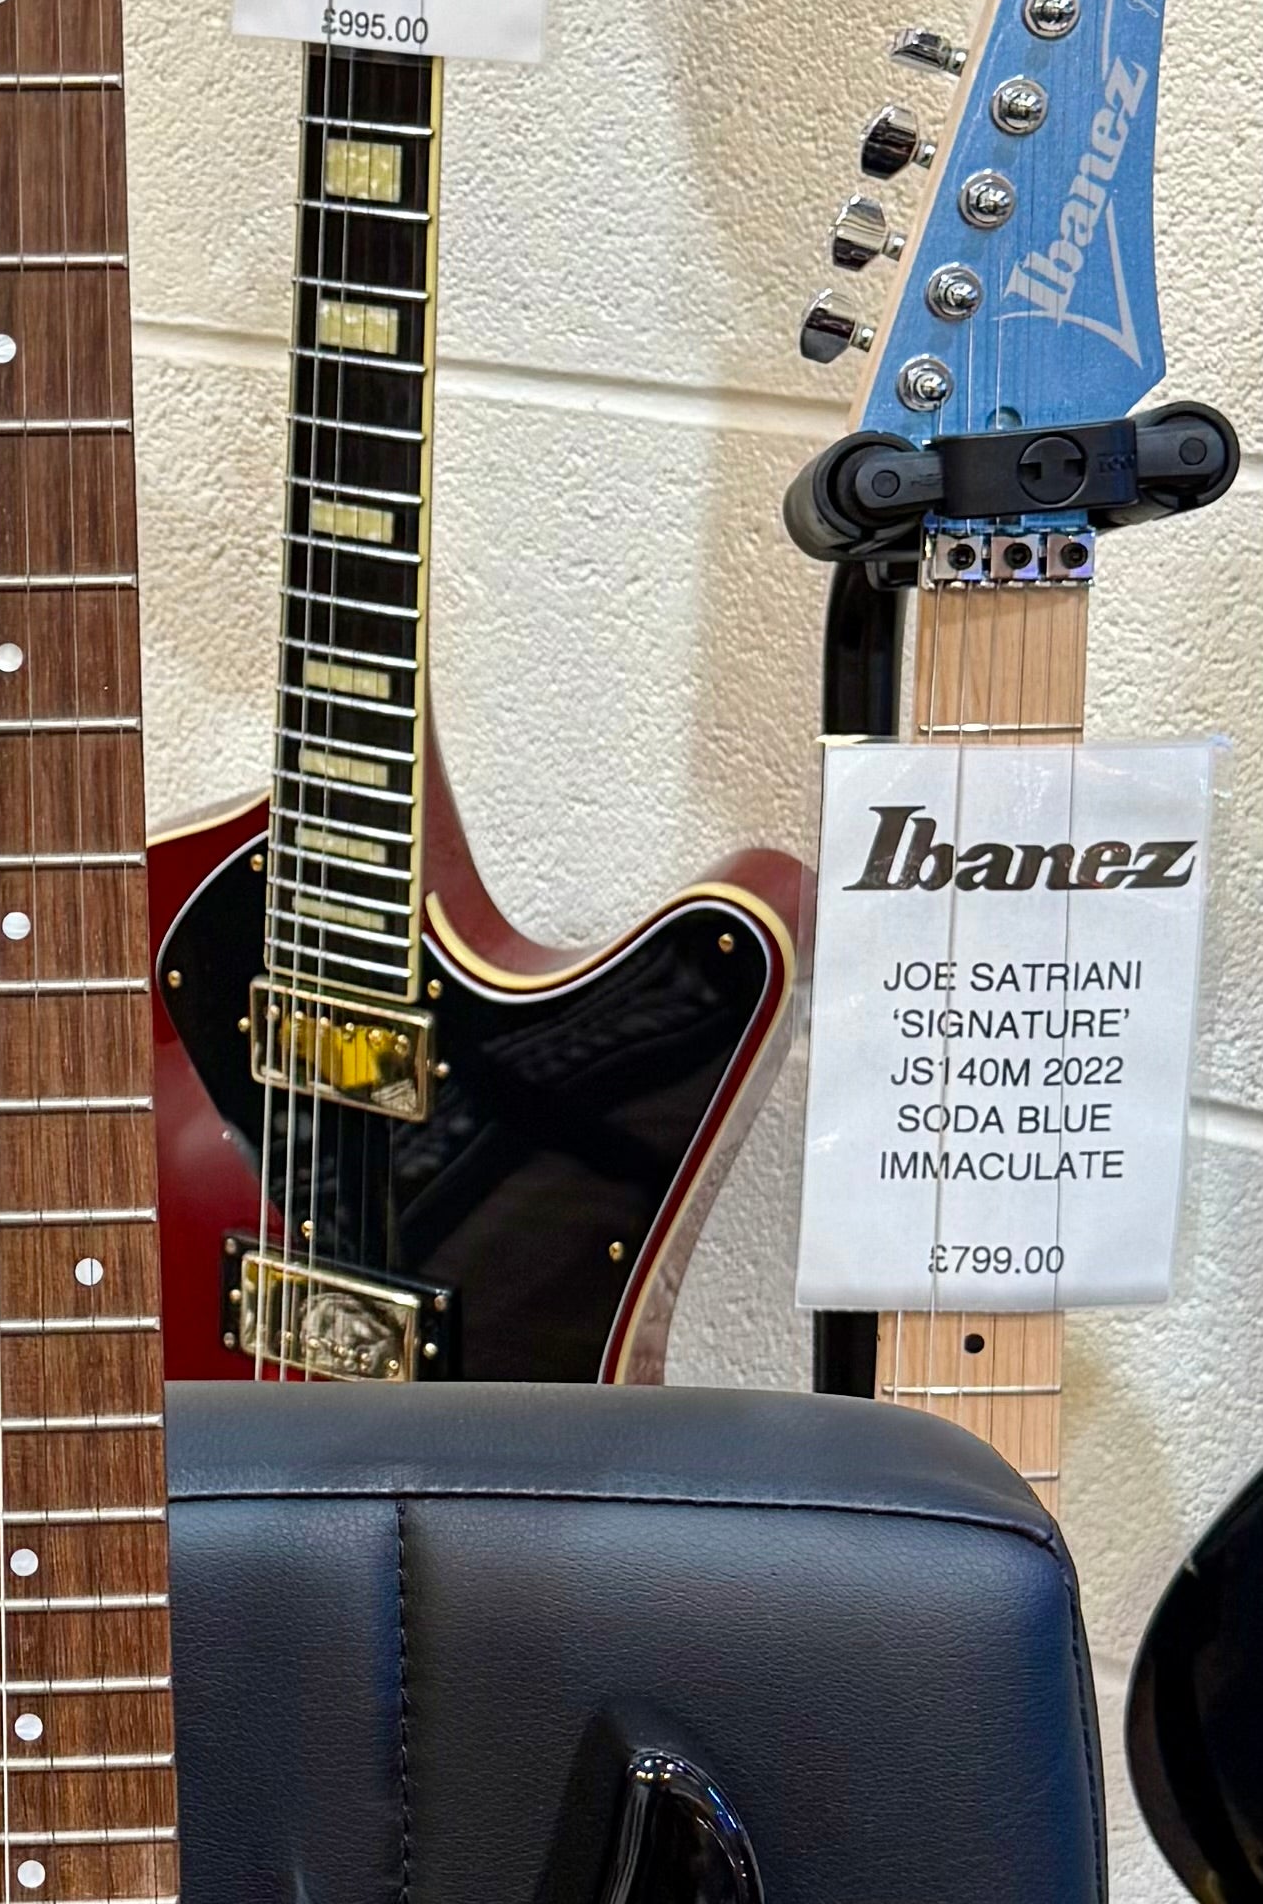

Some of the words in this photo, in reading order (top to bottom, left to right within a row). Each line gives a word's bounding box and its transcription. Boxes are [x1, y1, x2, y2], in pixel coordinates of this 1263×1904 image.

[321, 7, 429, 44] £995.00
[1002, 55, 1148, 327] Ibanez
[843, 805, 1199, 893] Ibanez
[883, 961, 958, 993] JOE
[969, 960, 1143, 992] SATRIANI
[890, 1056, 1030, 1088] JS140M
[1043, 1056, 1125, 1087] 2022
[897, 1103, 1004, 1135] SODA
[1018, 1103, 1113, 1134] BLUE
[880, 1150, 1125, 1182] IMMACULATE
[928, 1243, 1065, 1275] £799.00
